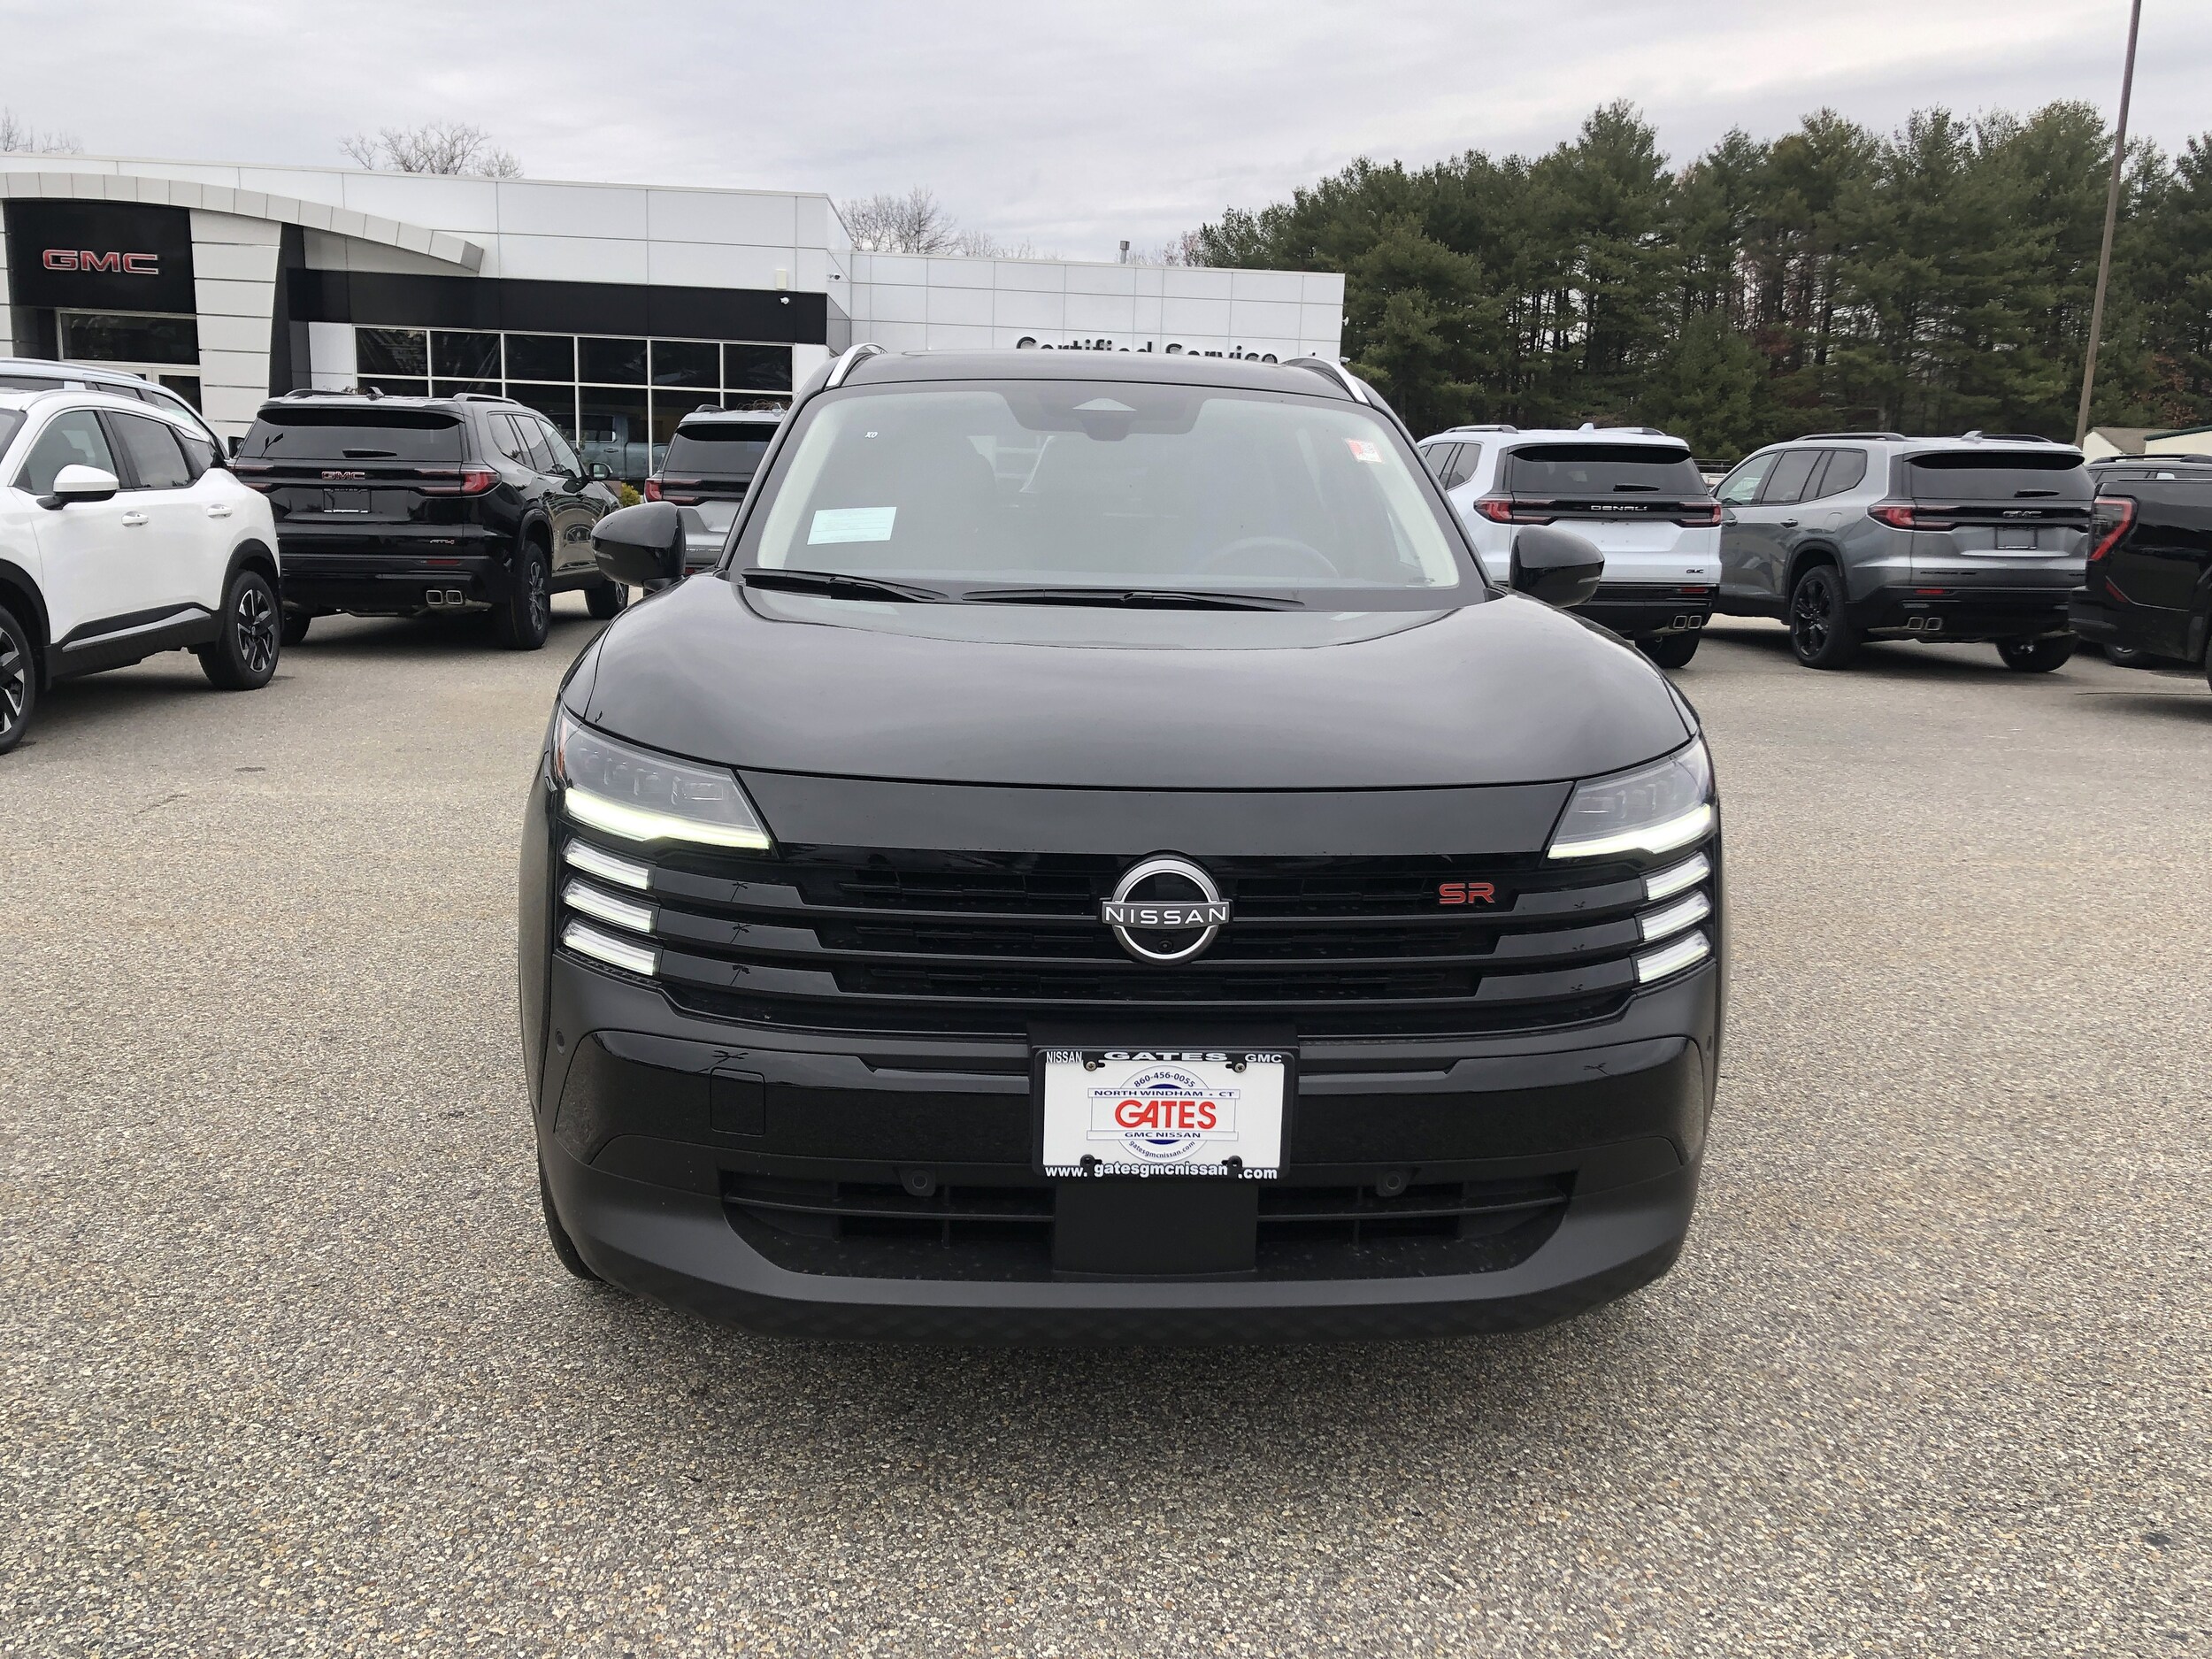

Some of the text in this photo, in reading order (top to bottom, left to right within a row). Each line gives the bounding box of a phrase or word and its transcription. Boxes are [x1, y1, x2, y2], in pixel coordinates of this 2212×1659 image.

[42, 249, 159, 275] GMC
[1016, 336, 1153, 353] Ctifid
[321, 471, 365, 480] GMC
[1438, 882, 1495, 904] SR
[1105, 906, 1226, 925] NISSAN
[1046, 1051, 1283, 1064] NISSAN GATES GMC
[1133, 1071, 1196, 1088] 860-456-0055
[1114, 1099, 1217, 1130] GATES
[1129, 1141, 1195, 1159] gatesgmcnissan.com
[1045, 1161, 1278, 1179] www. gatesgmcnissan .com
